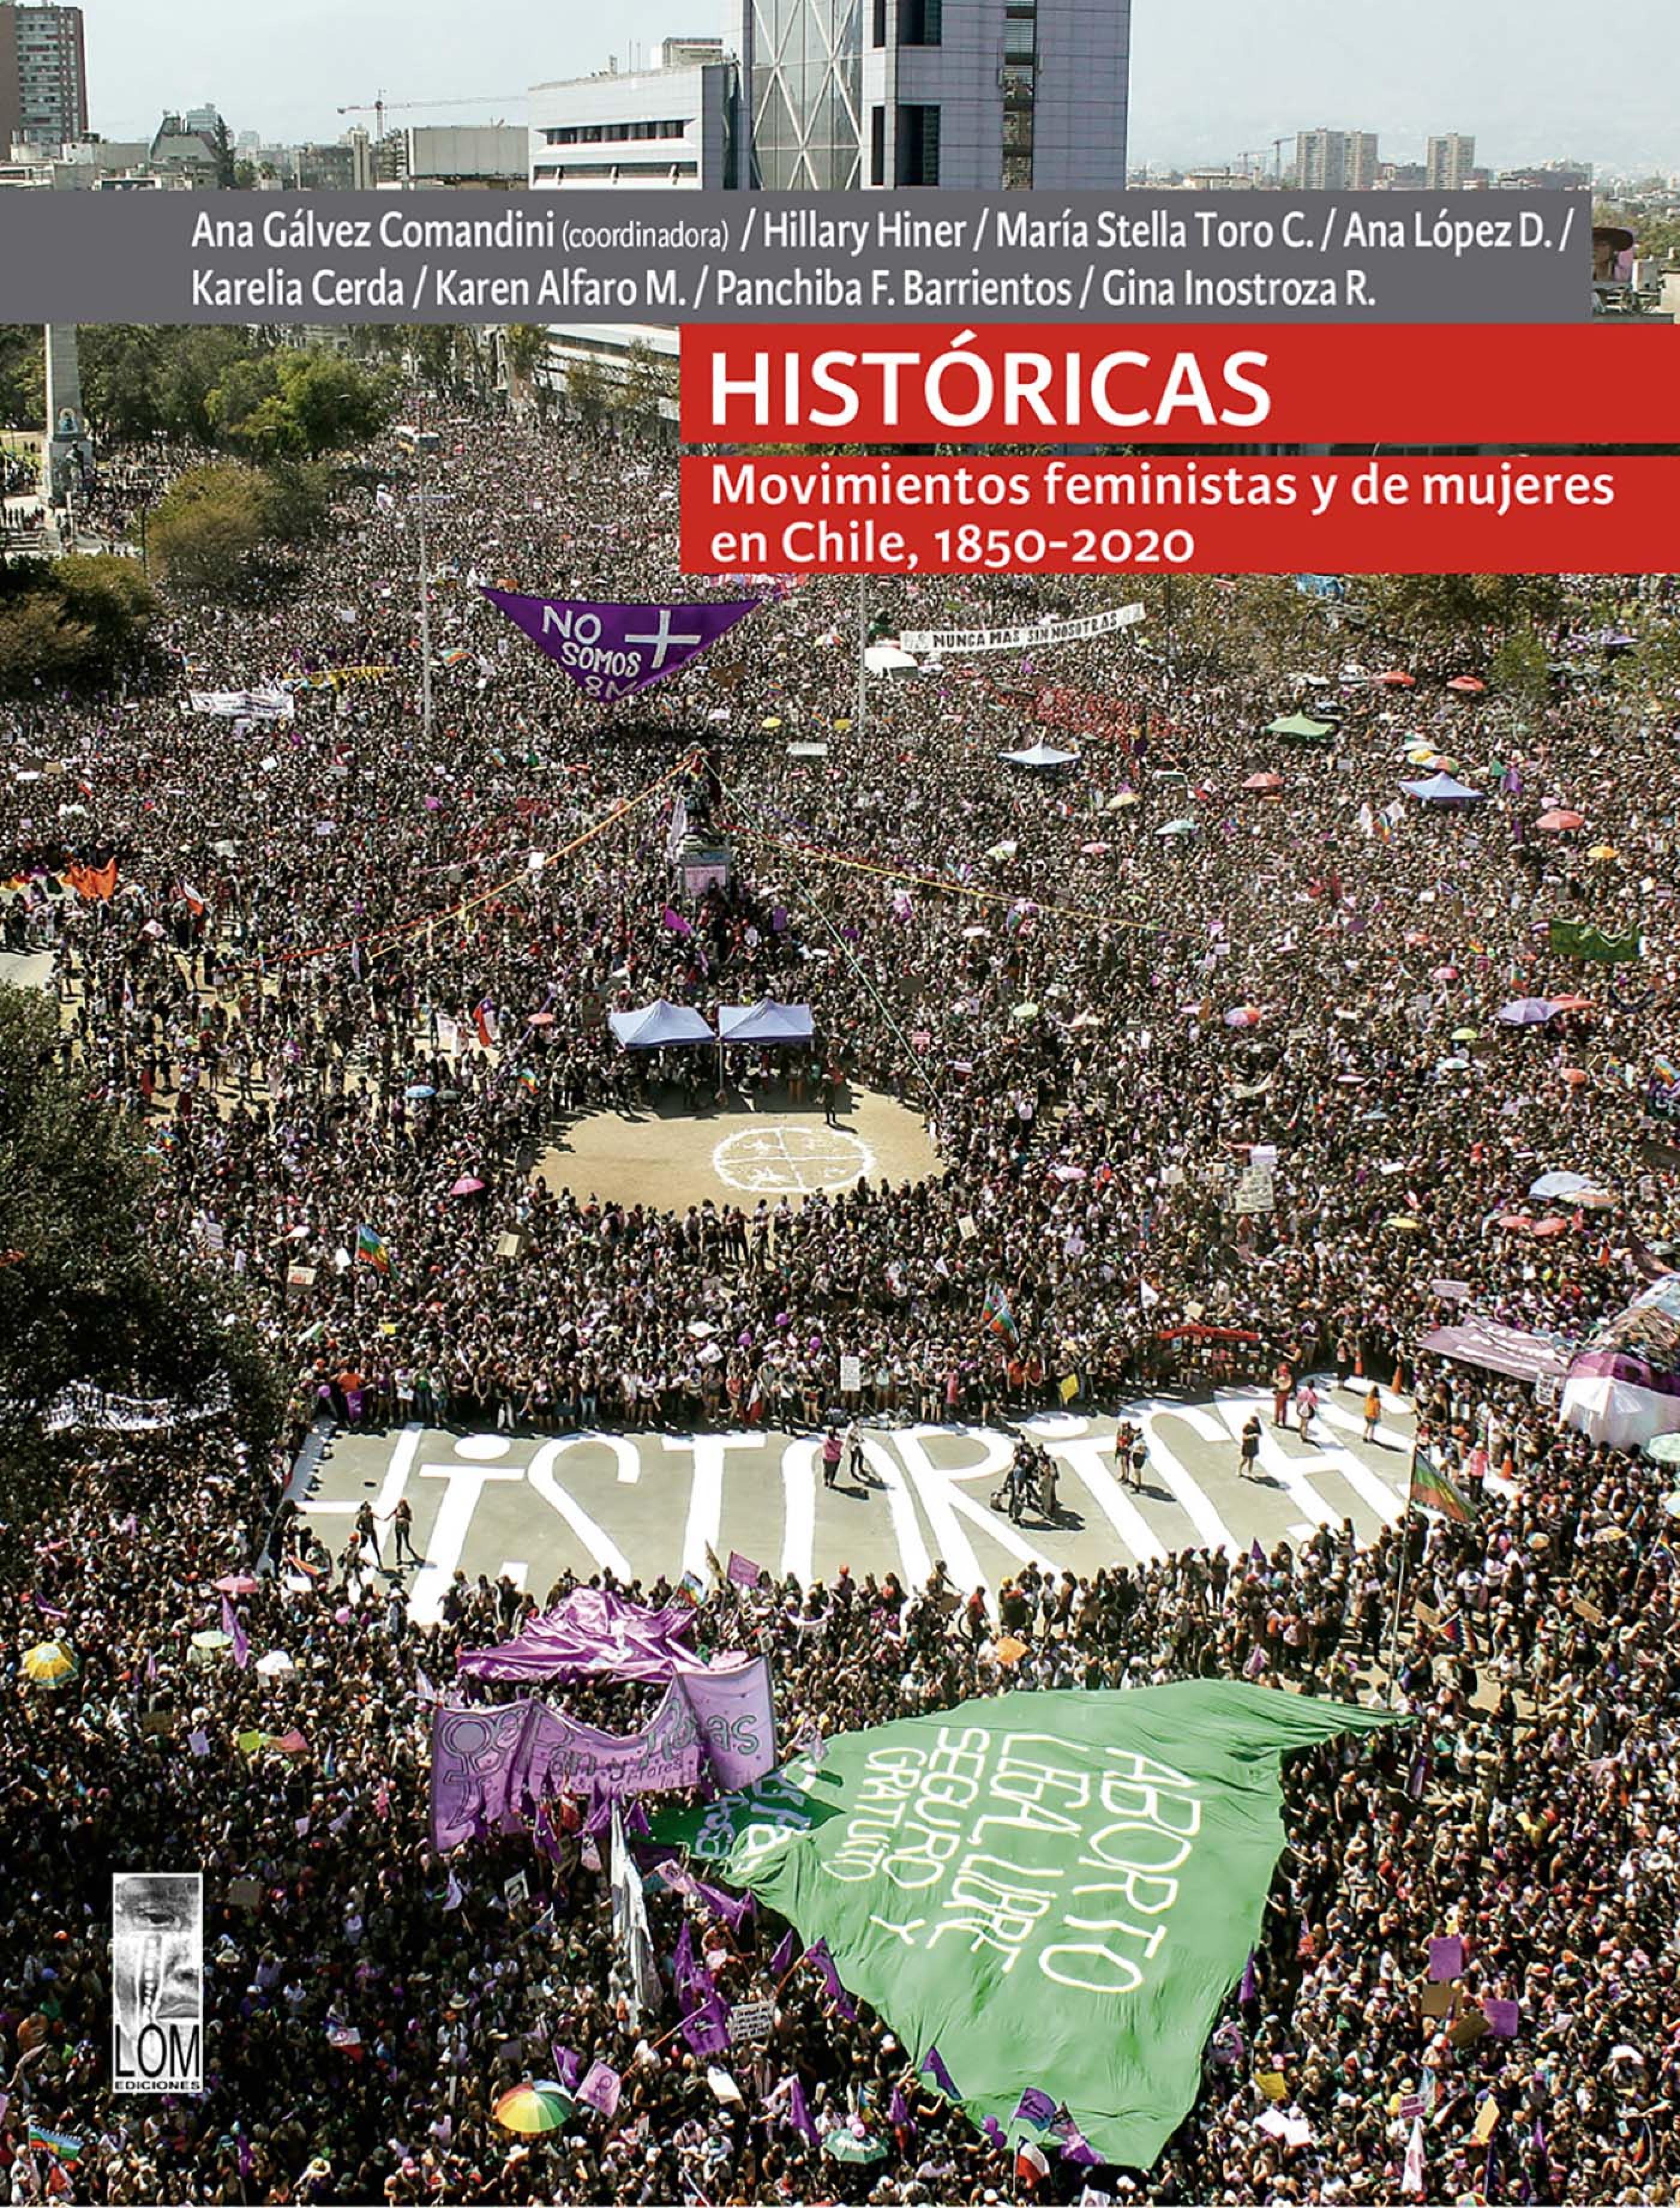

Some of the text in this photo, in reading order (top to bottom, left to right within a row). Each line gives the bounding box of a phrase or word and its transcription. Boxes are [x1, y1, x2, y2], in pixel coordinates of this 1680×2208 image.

[542, 605, 602, 644] NO
[560, 641, 641, 677] SOMOS
[932, 613, 1118, 648] NUNCA MAS SIN NOSOTRAS
[869, 1727, 991, 1945] SEGURO Y
[1039, 1747, 1201, 1992] ABORTO
[925, 1854, 1064, 1973] LIBRE
